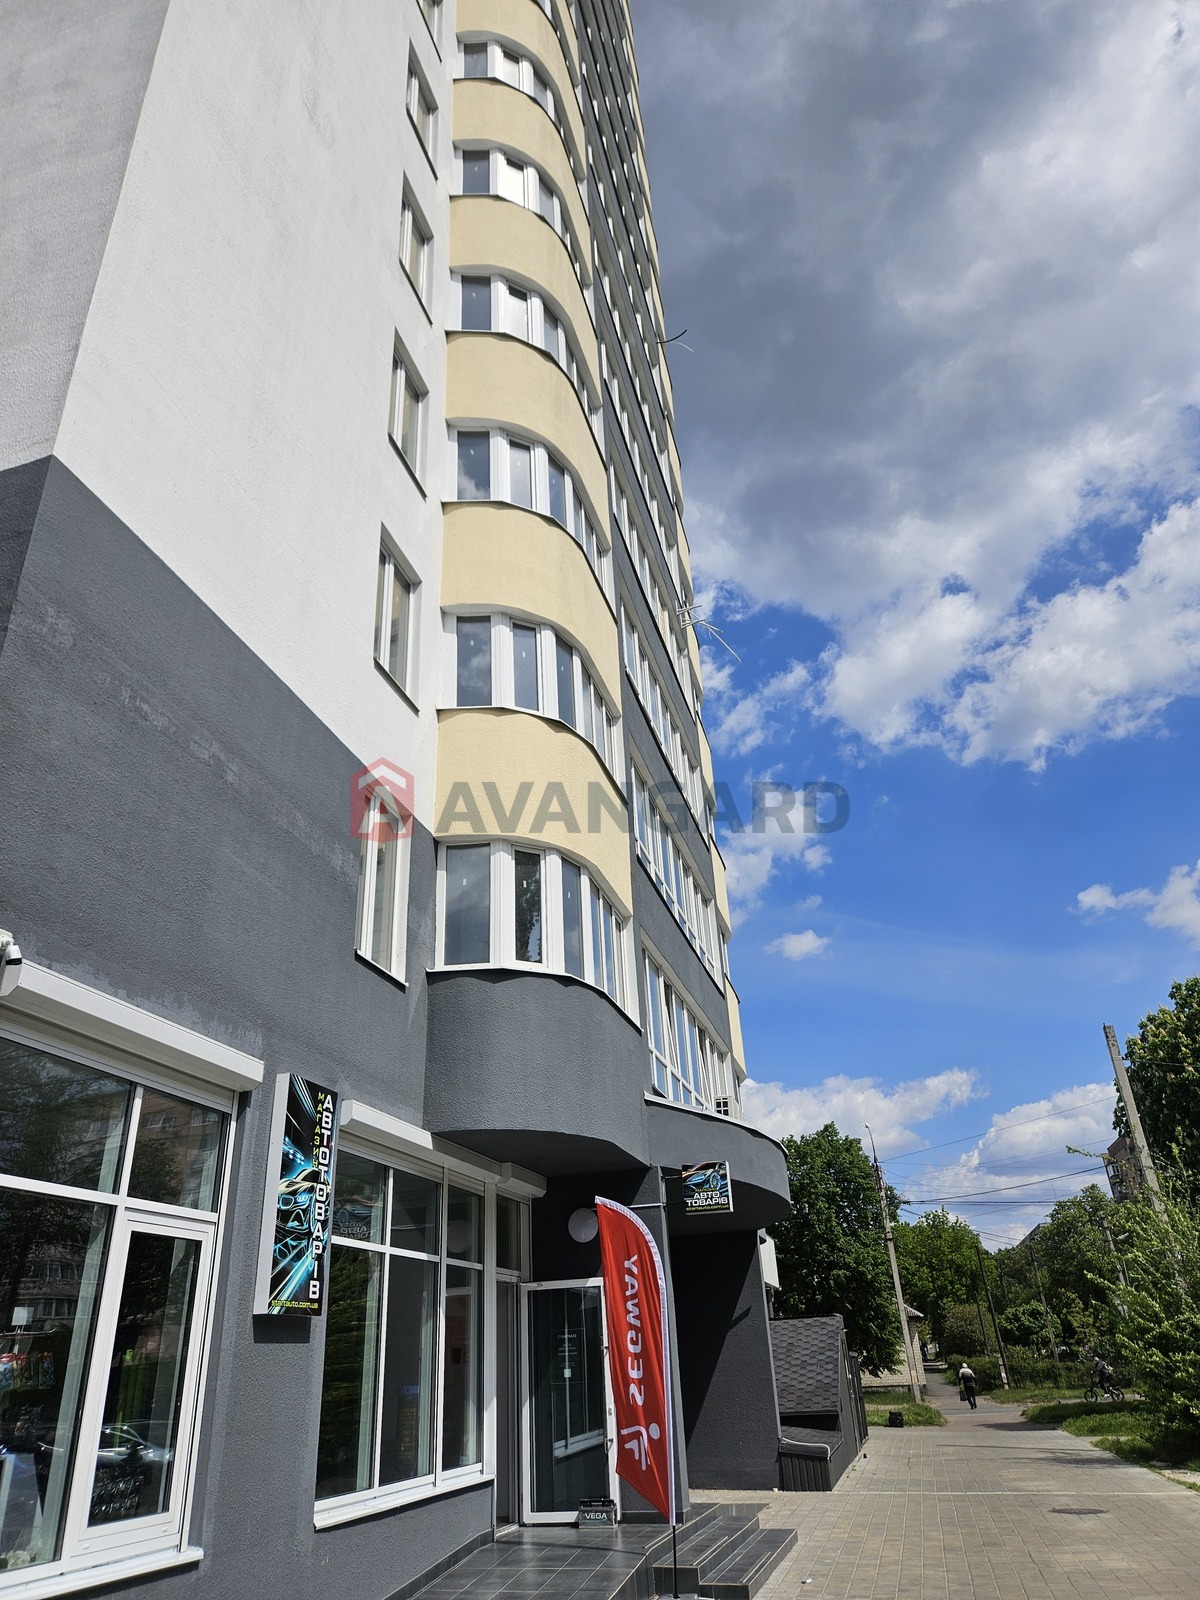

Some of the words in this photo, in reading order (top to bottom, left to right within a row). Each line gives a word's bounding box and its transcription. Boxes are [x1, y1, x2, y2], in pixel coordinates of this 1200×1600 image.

[312, 1092, 325, 1168] МАГАЗИН
[309, 1094, 334, 1299] АВТОТОВАРІВ
[686, 1197, 728, 1206] ТОВАРІВ
[694, 1191, 720, 1199] АВТО
